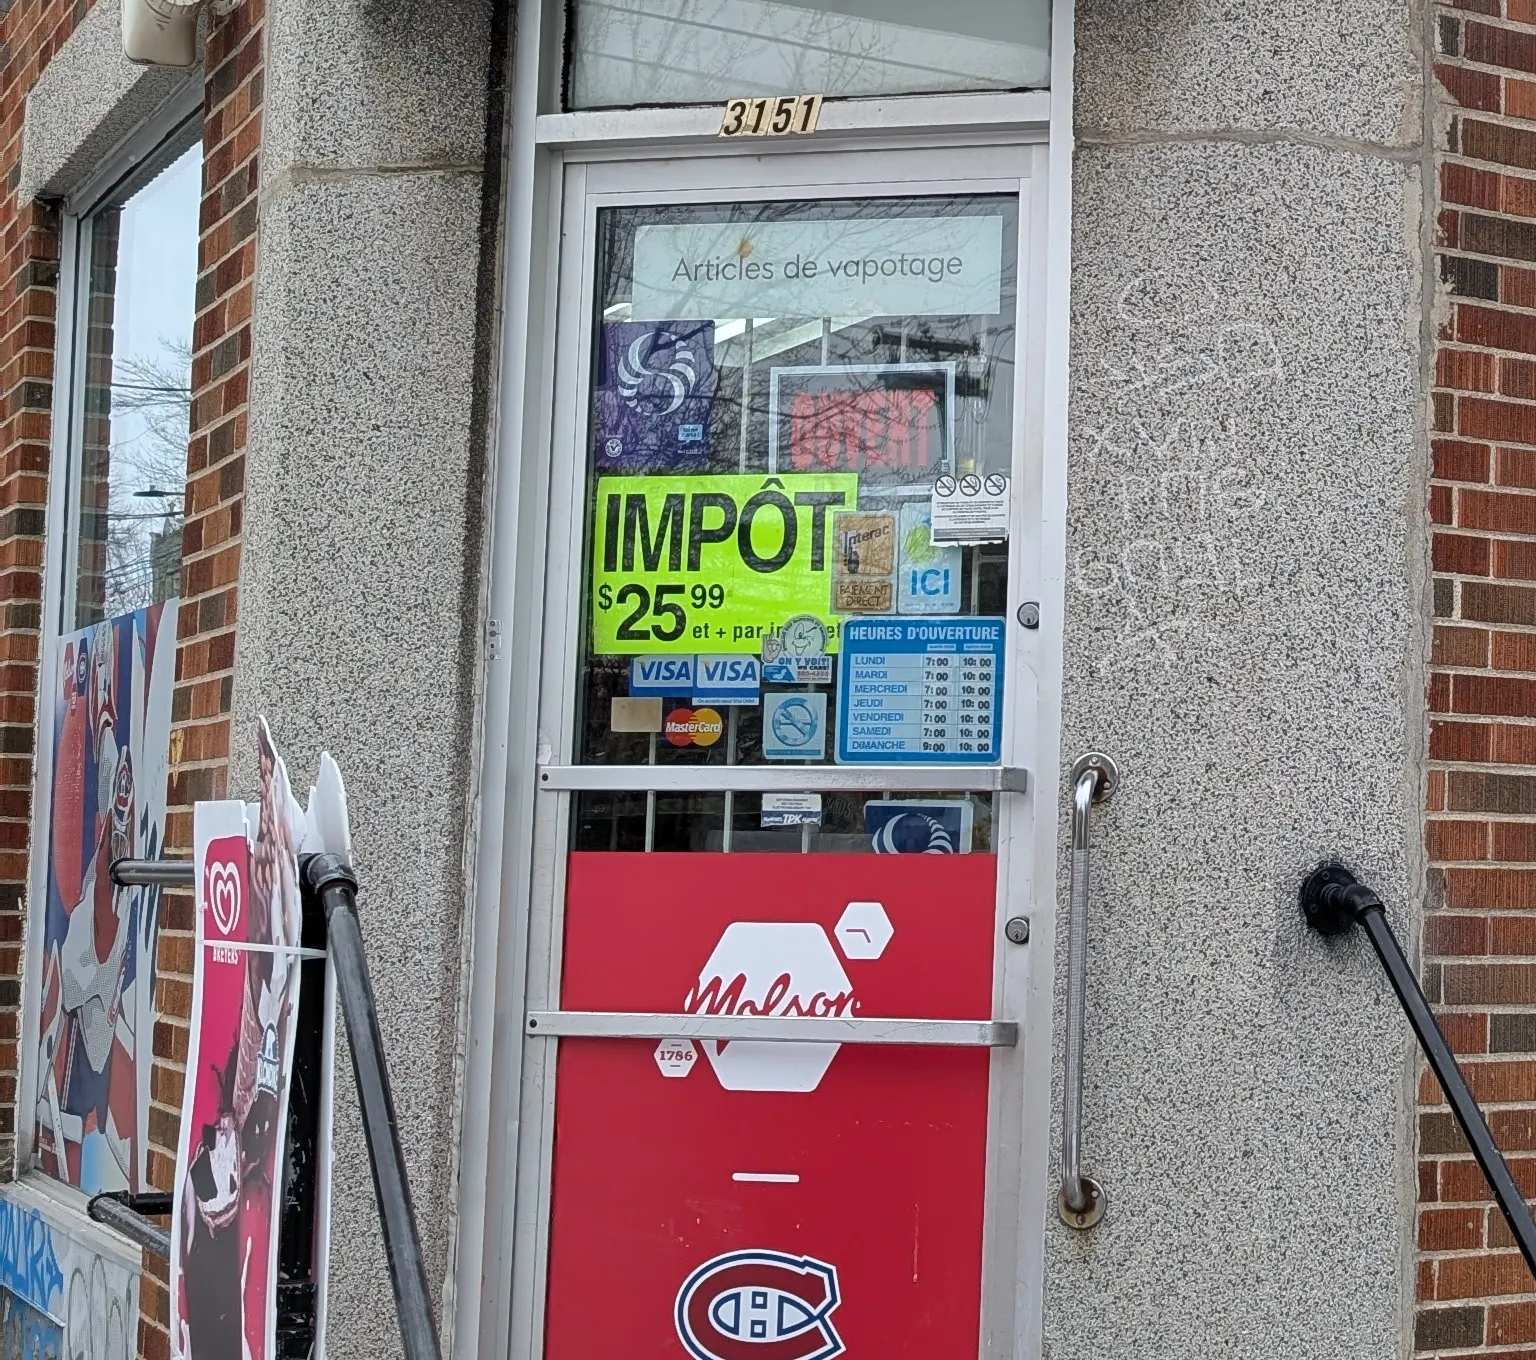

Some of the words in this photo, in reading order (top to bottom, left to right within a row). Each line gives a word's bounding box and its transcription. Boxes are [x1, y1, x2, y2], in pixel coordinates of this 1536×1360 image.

[724, 96, 820, 135] 3151
[672, 256, 774, 282] Articles
[783, 254, 817, 279] de
[826, 254, 963, 284] vapotage
[604, 478, 845, 573] IMPÔT
[911, 569, 950, 596] ICI
[840, 585, 888, 595] PAIEMENT
[846, 596, 881, 607] DIRECT
[692, 623, 709, 639] et
[715, 627, 727, 638] +
[733, 625, 763, 642] par
[850, 627, 902, 640] HEURES
[907, 627, 999, 640] D'OUVERTURE
[855, 657, 885, 665] LUNDI
[639, 661, 690, 681] VISA
[704, 661, 757, 681] VISA
[855, 671, 887, 679] MARDI
[854, 685, 907, 693] MERCREDI
[854, 699, 883, 707] JEUDI
[853, 713, 904, 721] VENDREDI
[665, 721, 721, 733] MasterCard
[852, 727, 891, 736] SAMEDI
[852, 741, 905, 750] DIMANCHE
[783, 814, 802, 824] TPK
[658, 1051, 693, 1061] 1786
